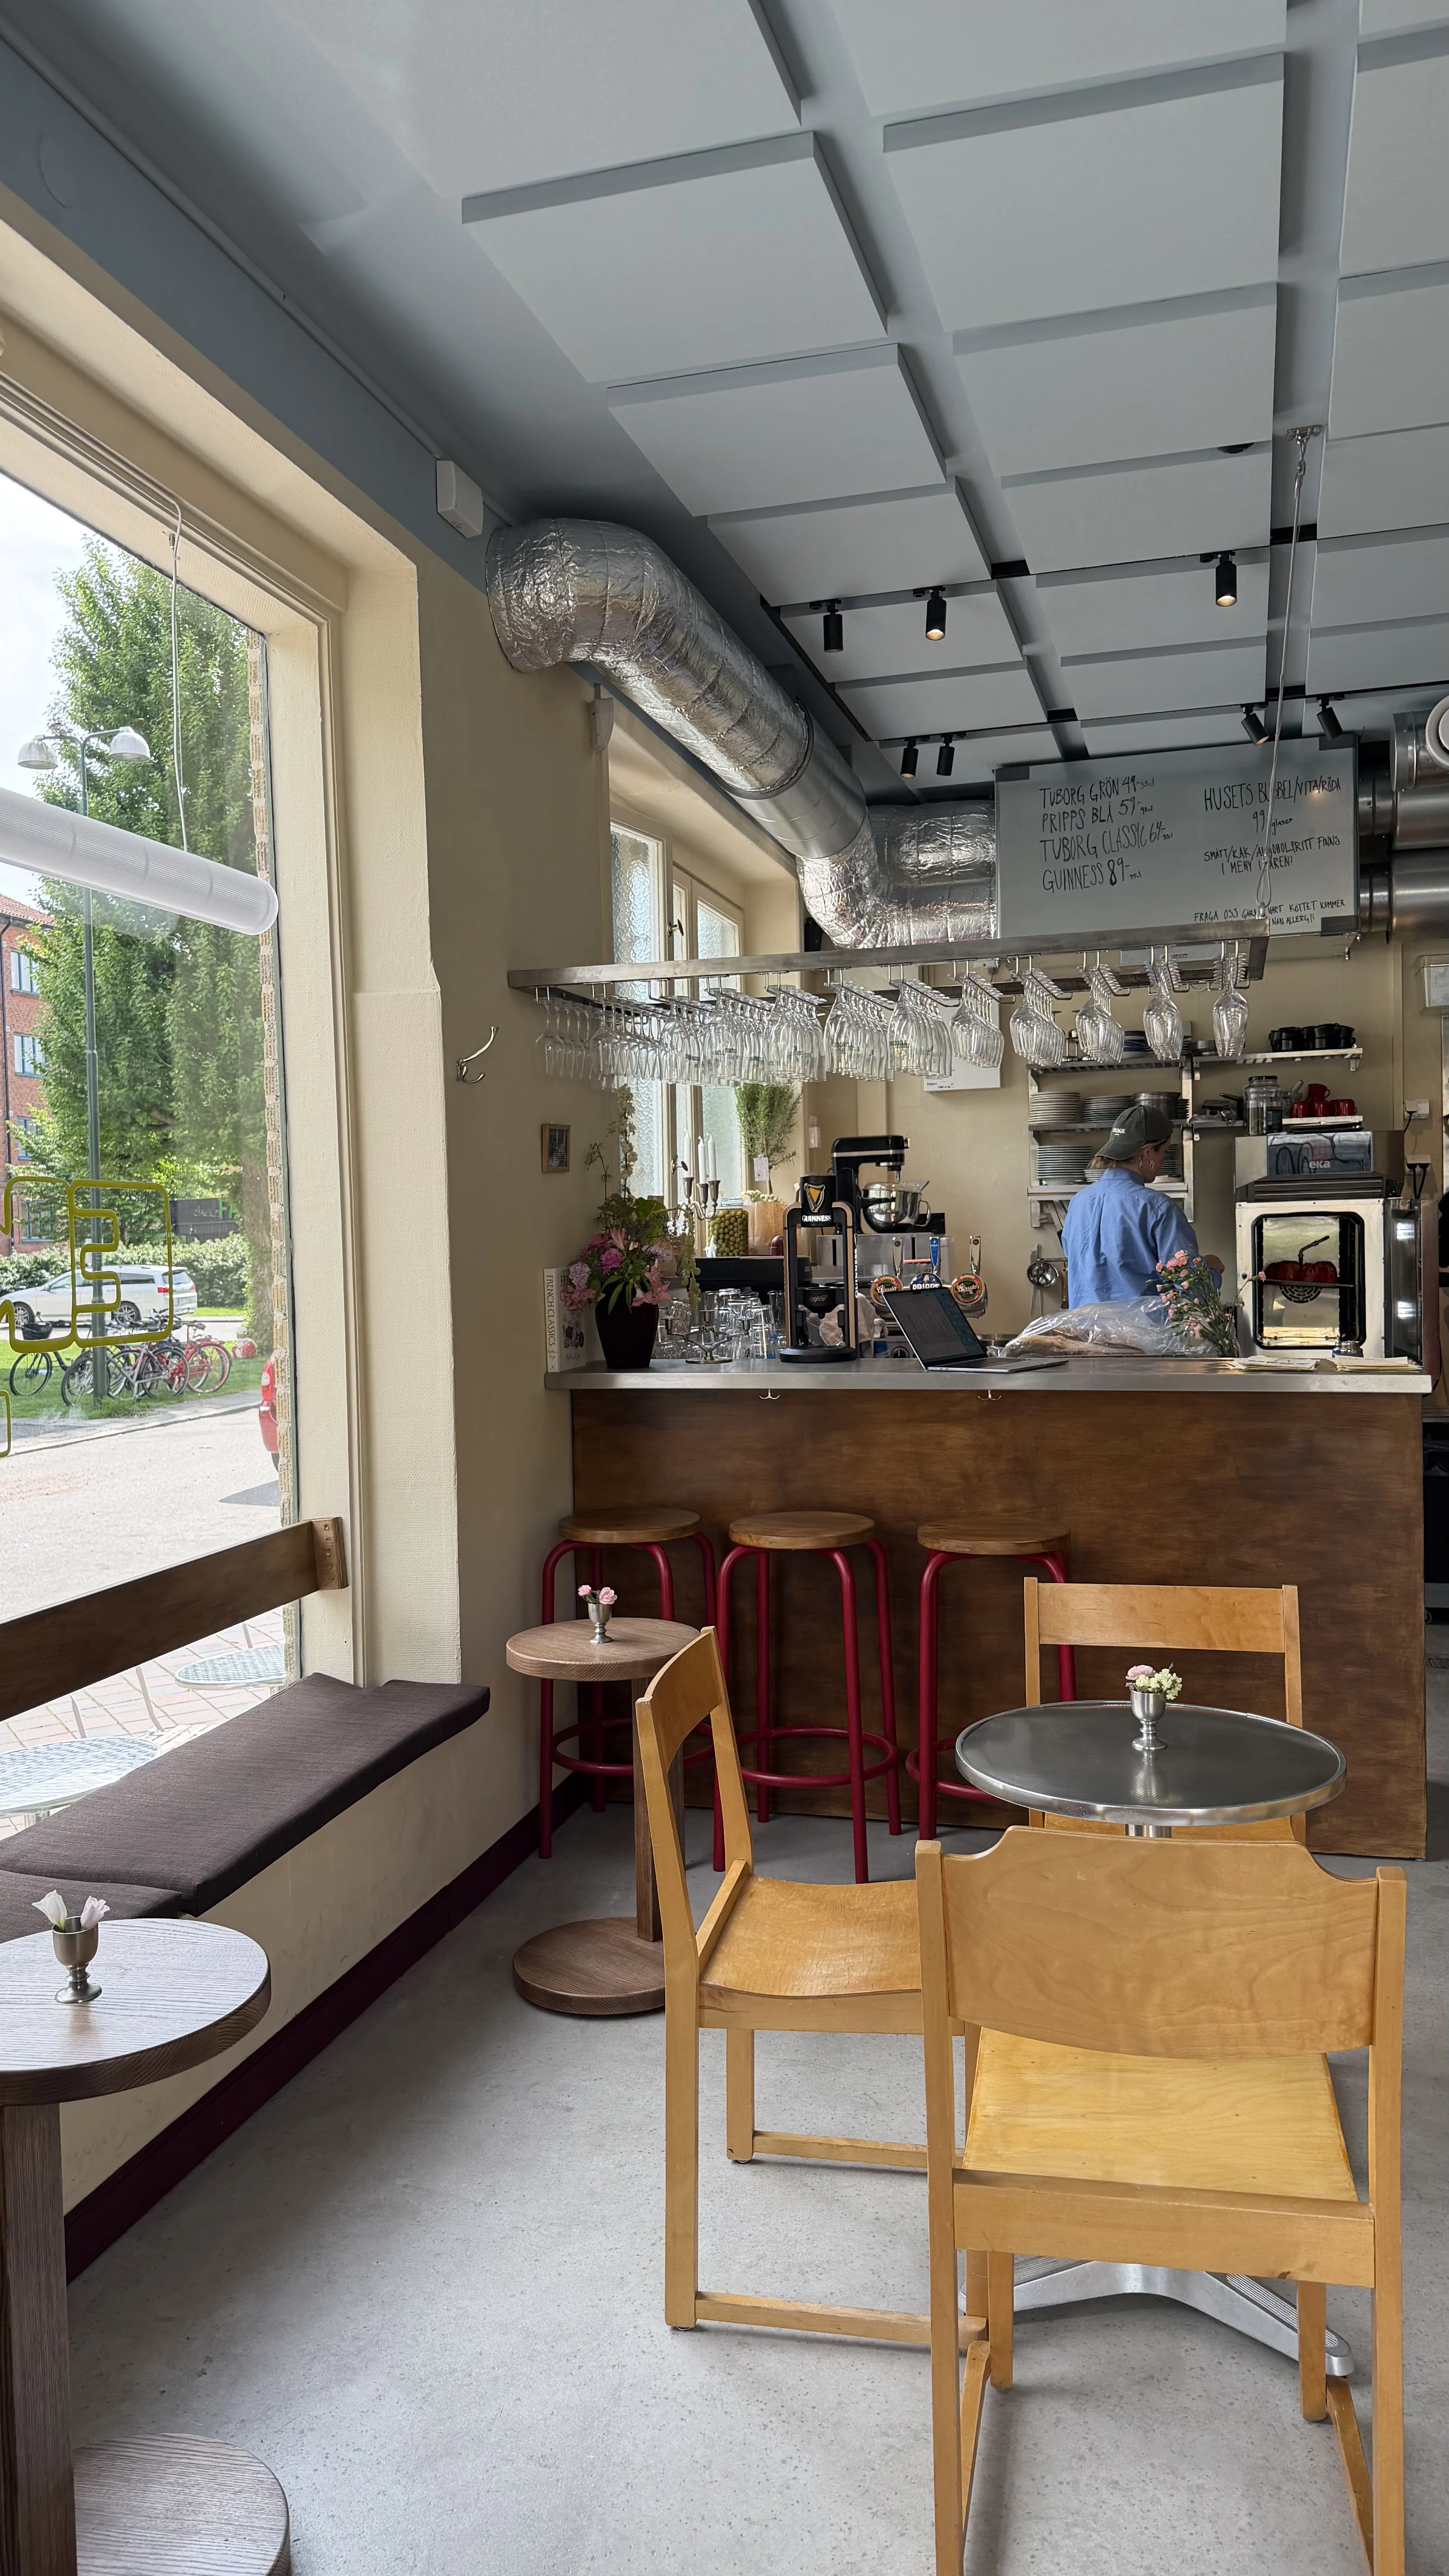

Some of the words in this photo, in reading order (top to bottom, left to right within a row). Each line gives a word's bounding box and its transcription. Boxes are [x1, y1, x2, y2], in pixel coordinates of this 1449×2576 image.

[1039, 786, 1084, 809] TUBORG
[1090, 777, 1119, 803] GRÖN
[1204, 783, 1253, 811] HUSETS
[1042, 808, 1086, 833] PRIPPS
[1092, 801, 1113, 824] BLÅ
[1040, 833, 1098, 863] TUBORG
[1102, 822, 1147, 854] CLASSIC
[1317, 835, 1340, 849] FINNS
[1043, 862, 1104, 893] GUINNESS
[1230, 859, 1252, 874] MENY
[1262, 856, 1293, 870] AREN!
[1194, 910, 1219, 922] FRÅGA
[1289, 901, 1318, 912] KÖTTET
[1320, 899, 1345, 910] KOMMER
[546, 1275, 555, 1307] FRENCH
[547, 1309, 556, 1346] CLASSICS
